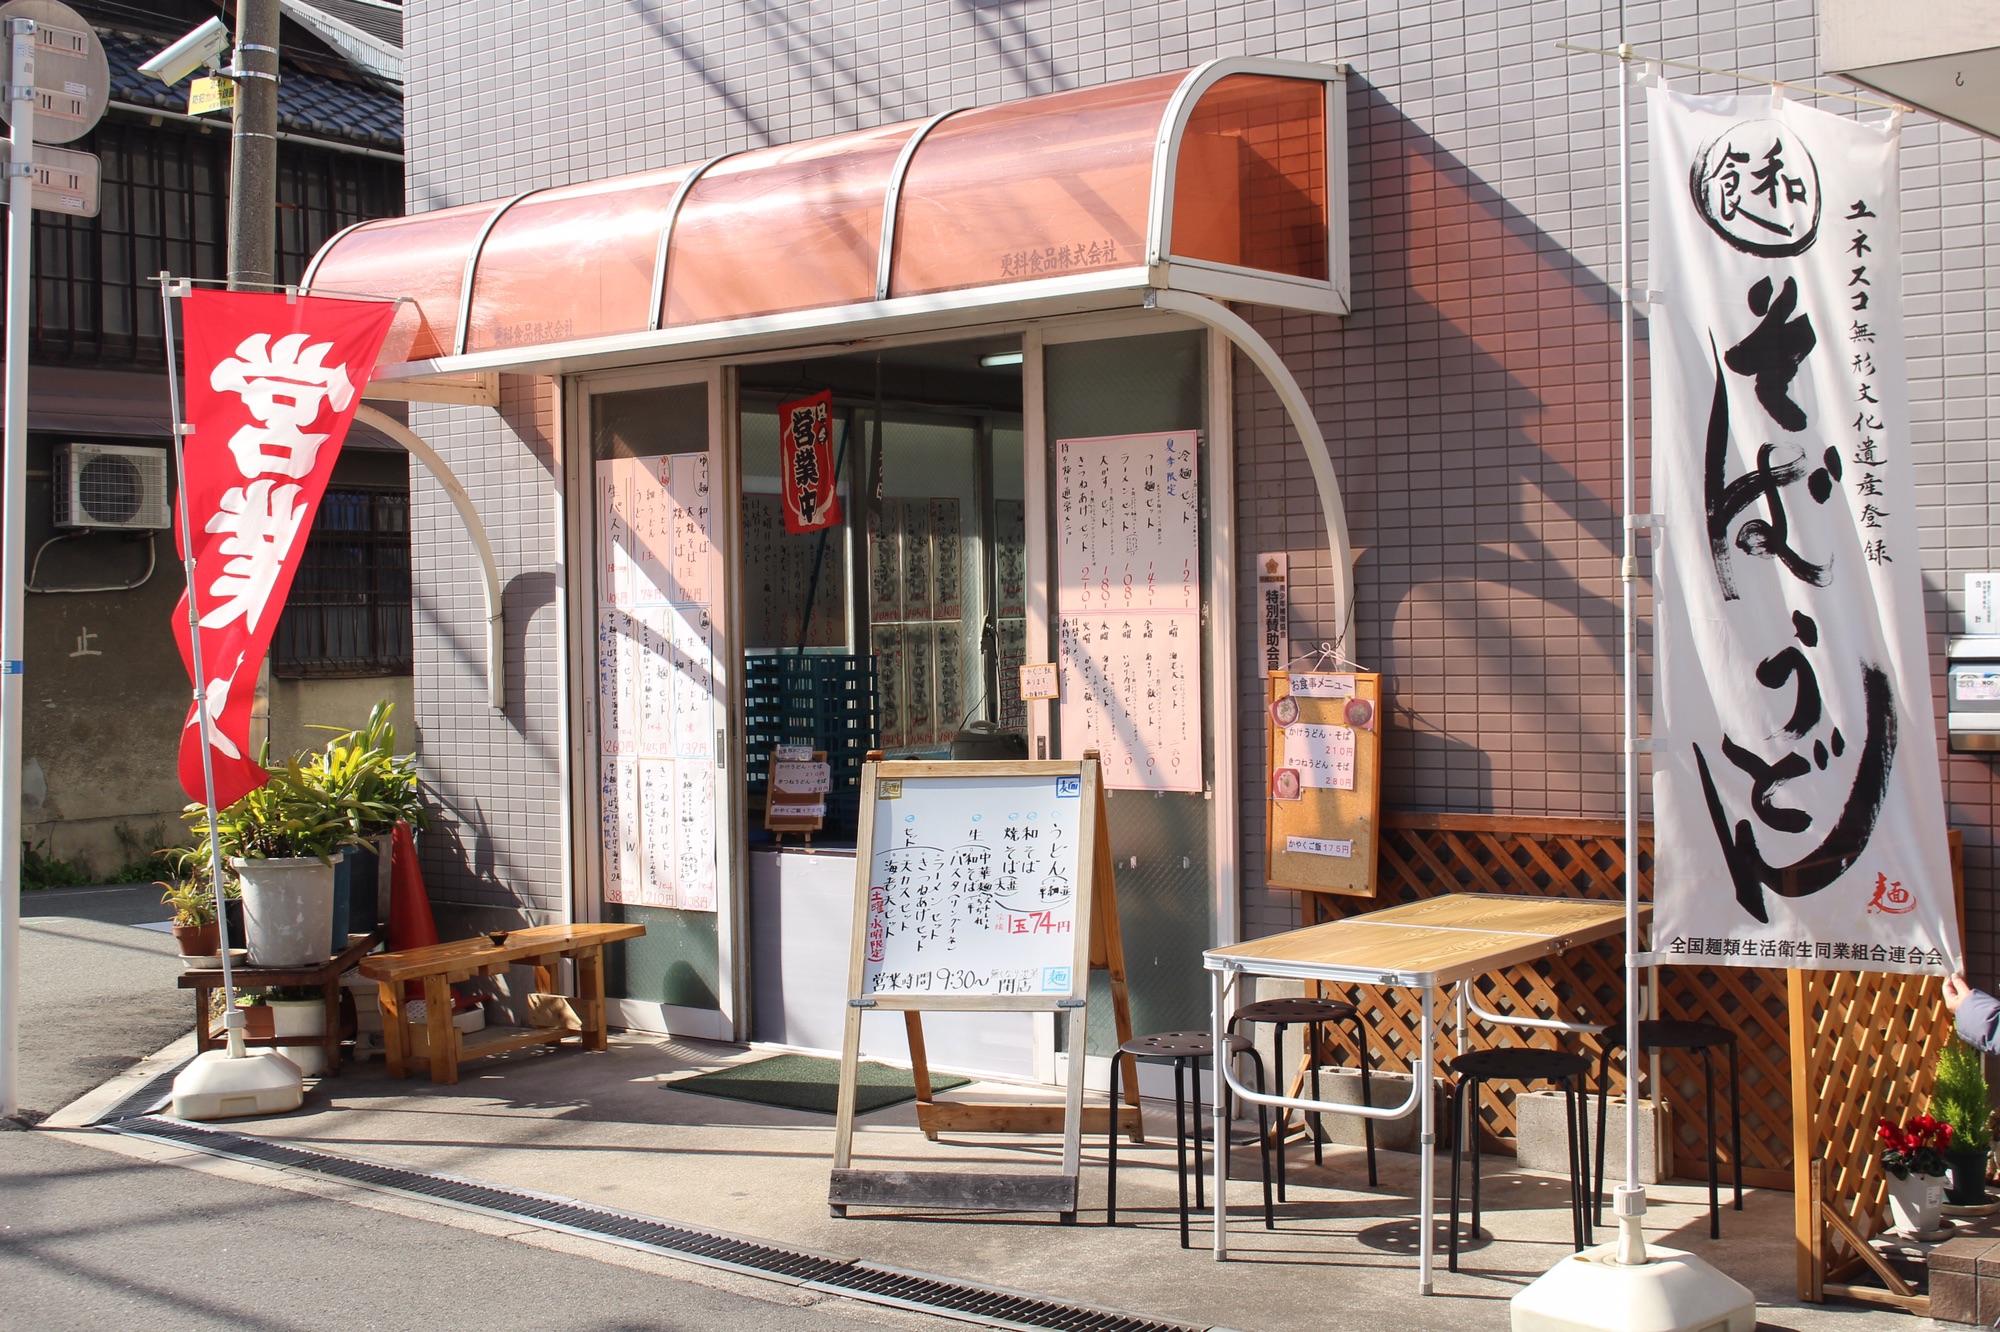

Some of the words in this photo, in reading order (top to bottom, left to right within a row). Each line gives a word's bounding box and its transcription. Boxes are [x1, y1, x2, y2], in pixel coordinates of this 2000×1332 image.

[1708, 138, 1807, 237] 和食
[1000, 238, 1118, 277] 更科食品株式会社
[1845, 200, 1893, 565] ユネスコ無形文化遺産登録
[792, 407, 819, 525] 営業中
[1166, 438, 1177, 496] 夏季限定
[1121, 453, 1131, 532] ラーメンセット
[69, 627, 102, 657] 止
[1266, 590, 1280, 671] 特別賛助会員
[1291, 675, 1353, 693] お食事メニュー
[1325, 746, 1353, 757] 210円
[882, 780, 900, 797] 麺
[1325, 777, 1353, 788] 280円
[967, 828, 984, 842] 生
[1003, 826, 1021, 875] 焼そば
[1021, 826, 1041, 874] 和そば
[1048, 823, 1068, 876] うどん
[963, 852, 978, 893] 和そば
[977, 852, 993, 892] 中華麺
[1868, 872, 1918, 914] 麺
[884, 859, 898, 939] 海老天セット
[915, 858, 931, 952] きつねあげセット
[929, 858, 945, 940] ラーメンセット
[1670, 936, 1943, 966] 全国麺類生活衛生同業組合連合会
[872, 970, 933, 992] 営業時間
